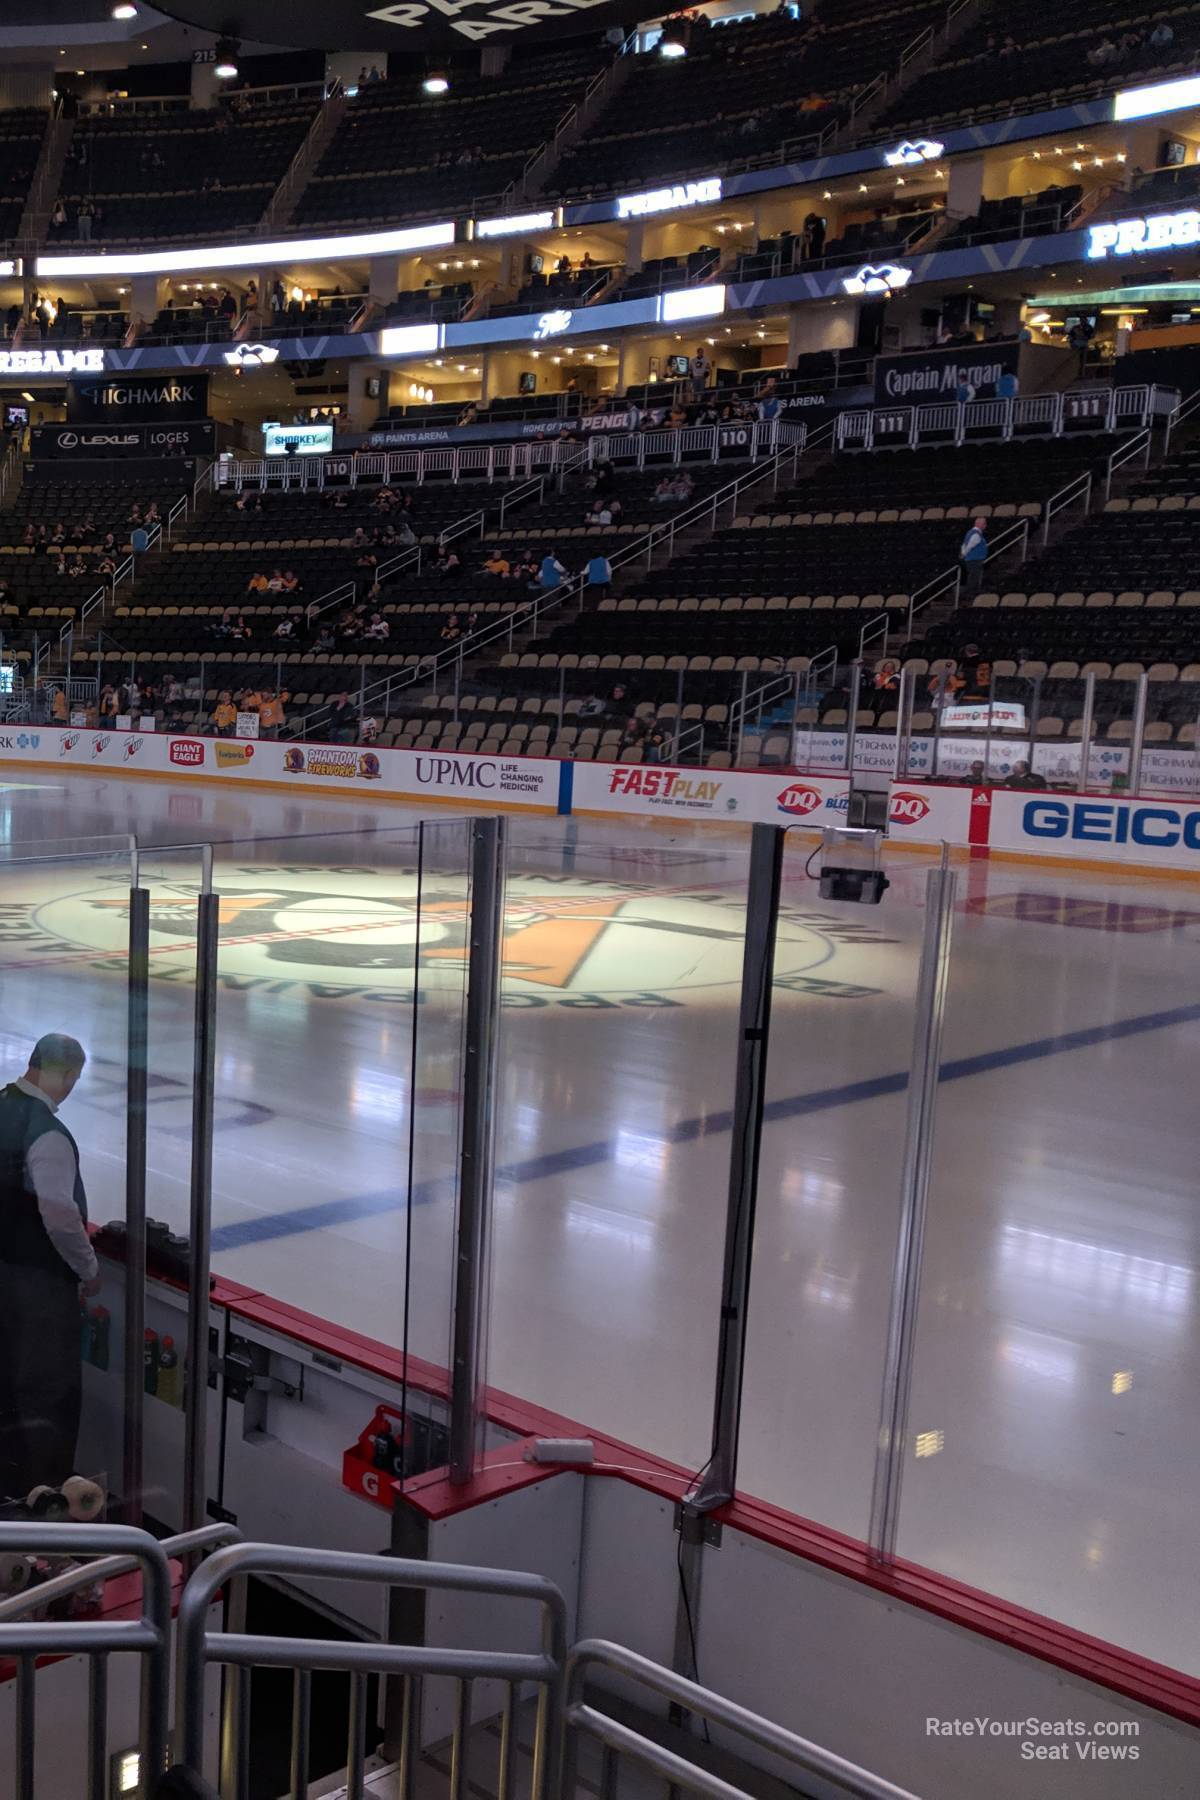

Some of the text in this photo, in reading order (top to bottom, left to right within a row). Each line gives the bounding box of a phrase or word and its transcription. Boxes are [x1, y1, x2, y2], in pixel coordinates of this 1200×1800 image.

[193, 50, 217, 63] 215
[885, 368, 940, 398] Captain
[93, 384, 195, 406] HIGHMARK
[789, 394, 826, 409] ARENA
[1072, 399, 1100, 418] 111
[879, 415, 904, 434] 111
[81, 431, 190, 446] LEXUS LOGES
[386, 432, 417, 443] PAINTS
[419, 430, 449, 442] ARENA
[721, 430, 747, 447] 110
[325, 462, 348, 476] 110
[172, 743, 201, 754] GIANT
[173, 752, 201, 762] EAGLE
[307, 749, 358, 765] PHANTOM
[306, 761, 357, 777] FIREWORKS
[415, 756, 497, 788] UPMC
[500, 763, 518, 773] LIFE
[500, 772, 544, 784] CHANGING
[499, 781, 540, 793] MEDICINE
[784, 788, 817, 809] DQ
[361, 1472, 380, 1497] G
